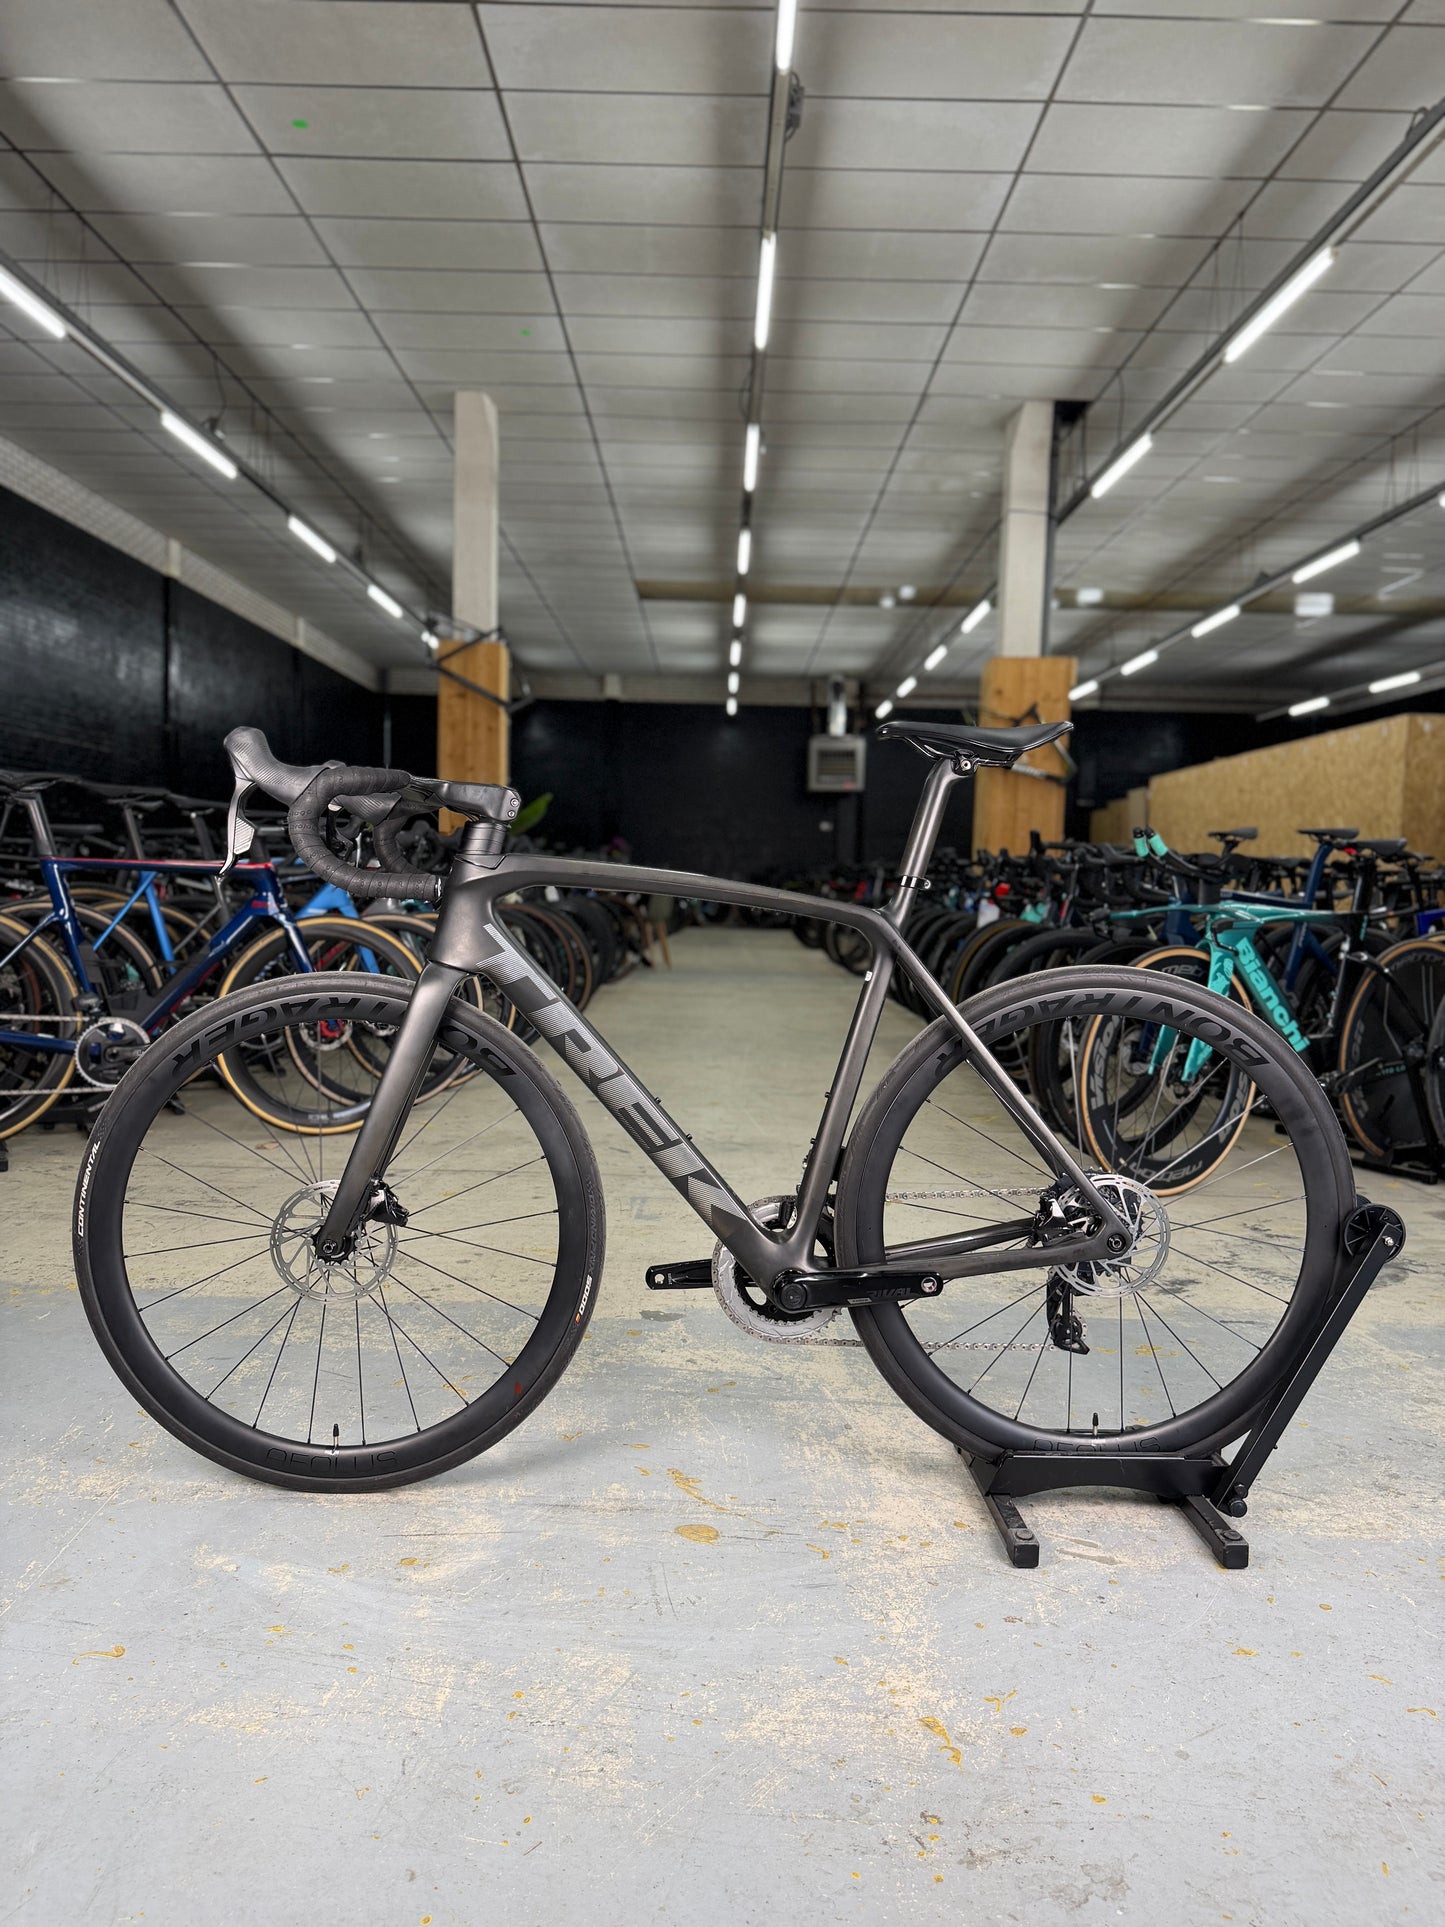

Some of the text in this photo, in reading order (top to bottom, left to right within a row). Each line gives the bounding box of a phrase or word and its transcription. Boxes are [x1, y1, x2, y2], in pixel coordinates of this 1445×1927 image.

[172, 995, 516, 1077] BOTRAGER
[1236, 936, 1310, 1053] Bianchi
[475, 923, 748, 1228] TREK
[77, 1140, 101, 1237] CONTINENTAL
[579, 1274, 593, 1314] 5000
